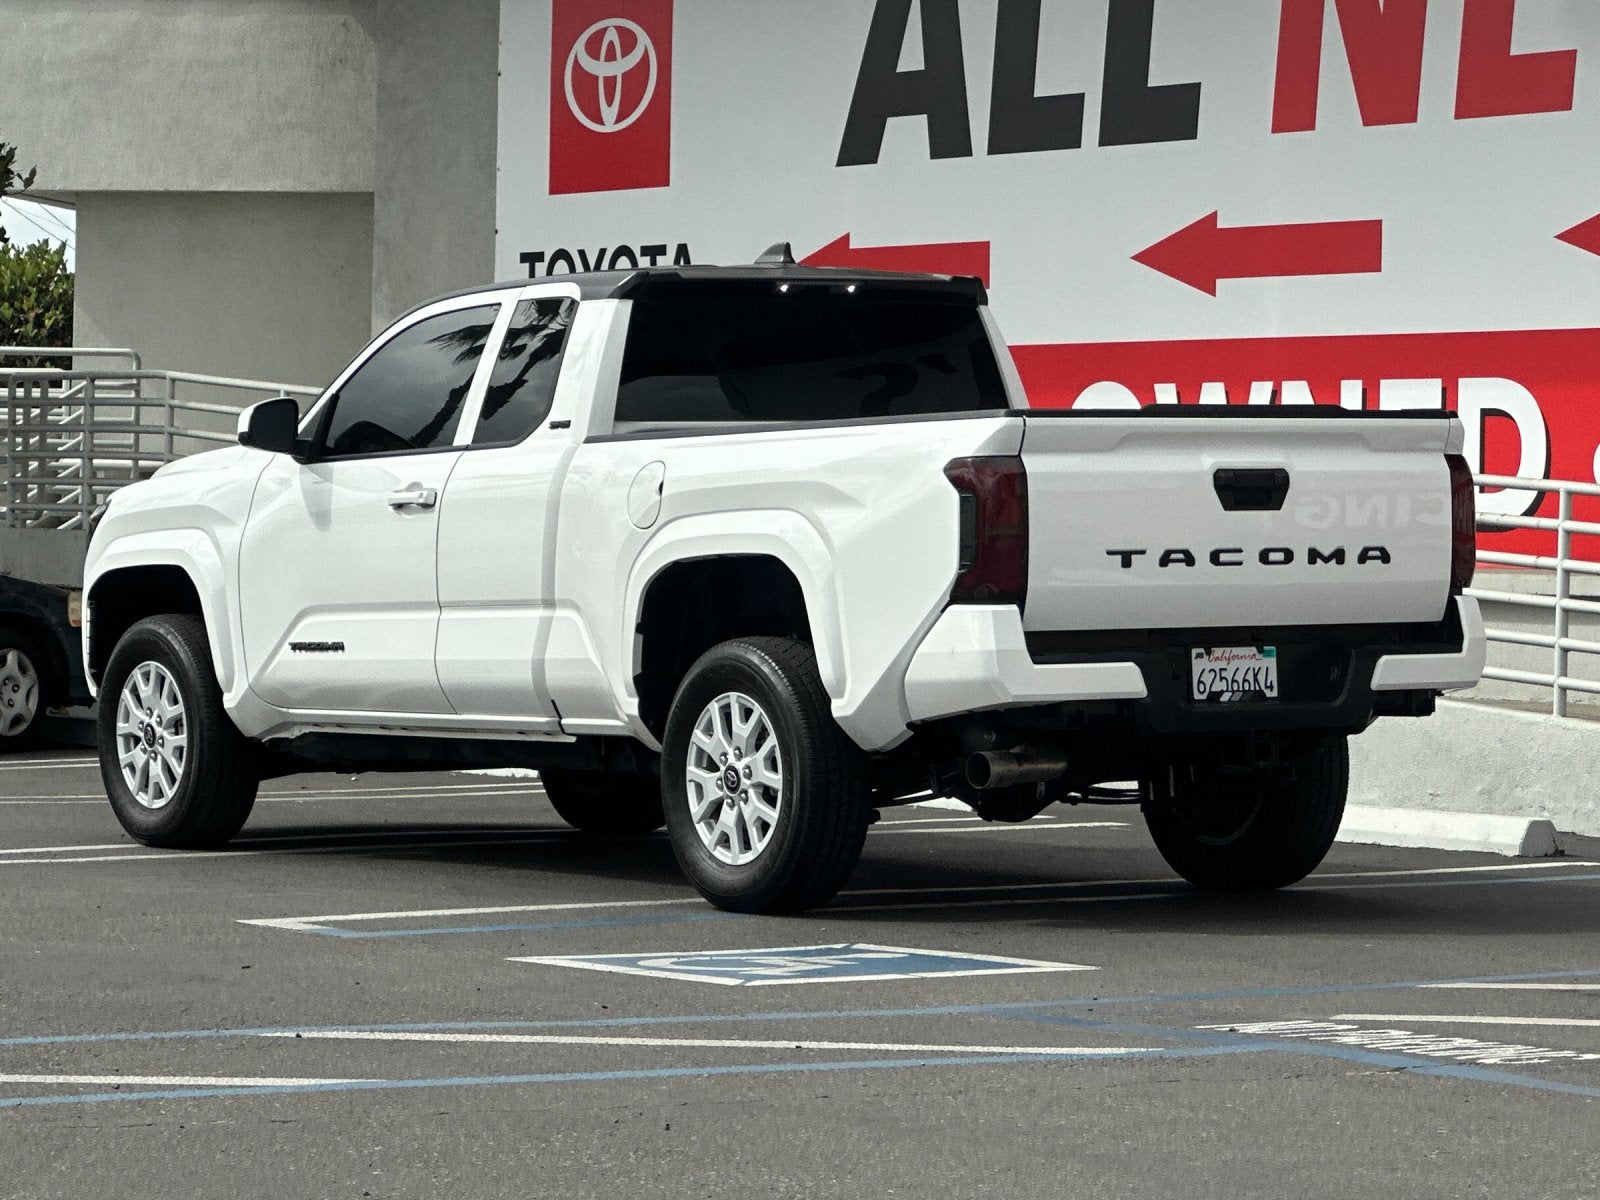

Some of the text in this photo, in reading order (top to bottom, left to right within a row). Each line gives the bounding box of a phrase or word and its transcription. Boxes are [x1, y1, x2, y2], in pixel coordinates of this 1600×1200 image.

[836, 0, 1202, 167] ALL
[1208, 649, 1261, 665] California
[1197, 667, 1274, 695] 62566K4
